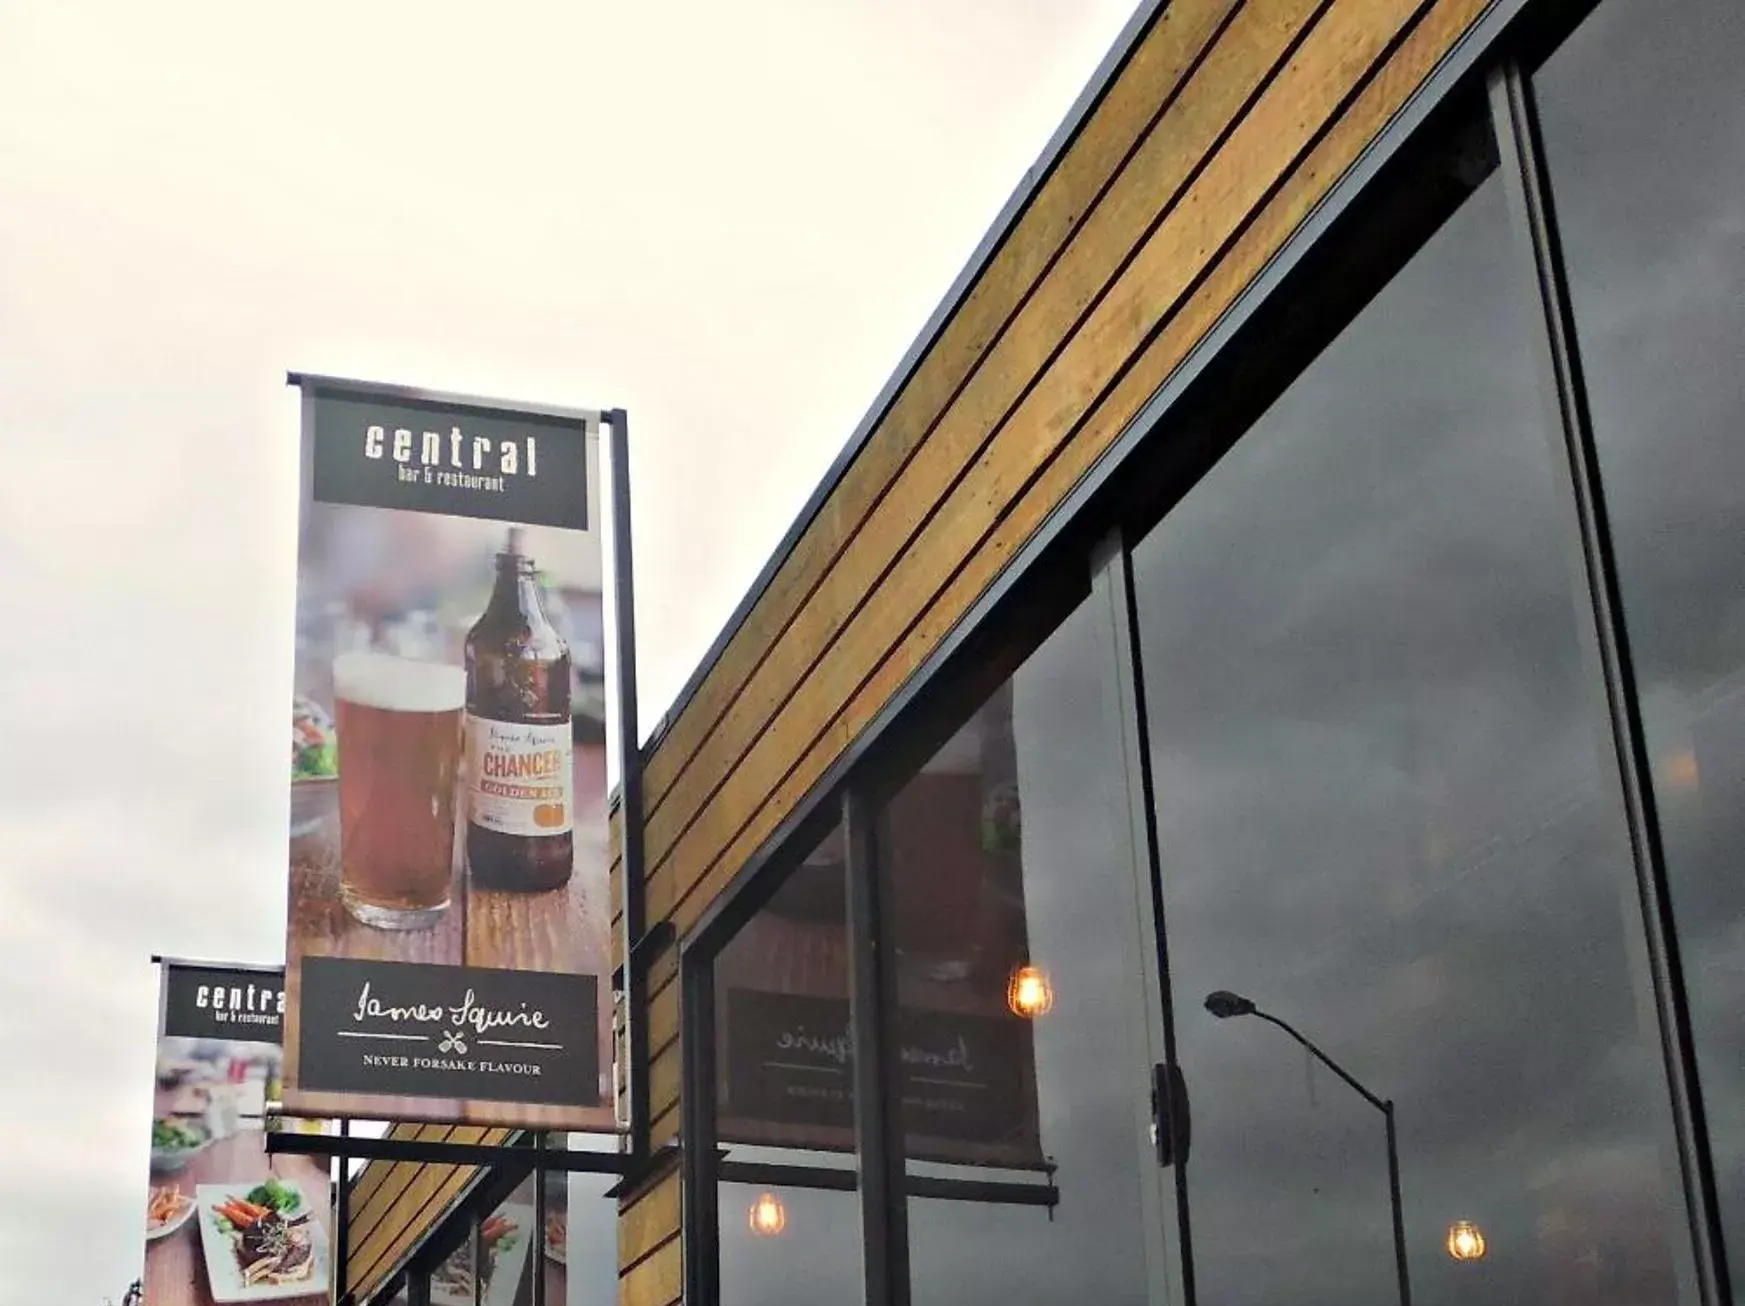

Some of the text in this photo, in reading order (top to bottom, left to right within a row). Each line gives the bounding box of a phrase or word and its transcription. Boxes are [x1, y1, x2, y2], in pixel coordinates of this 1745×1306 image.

[364, 425, 537, 477] central
[398, 464, 419, 482] bar
[437, 472, 506, 493] restaurant
[196, 984, 285, 1013] centra
[353, 981, 549, 1033] James Squire
[363, 1054, 542, 1076] NEVER FORSAKE FLAVOUR
